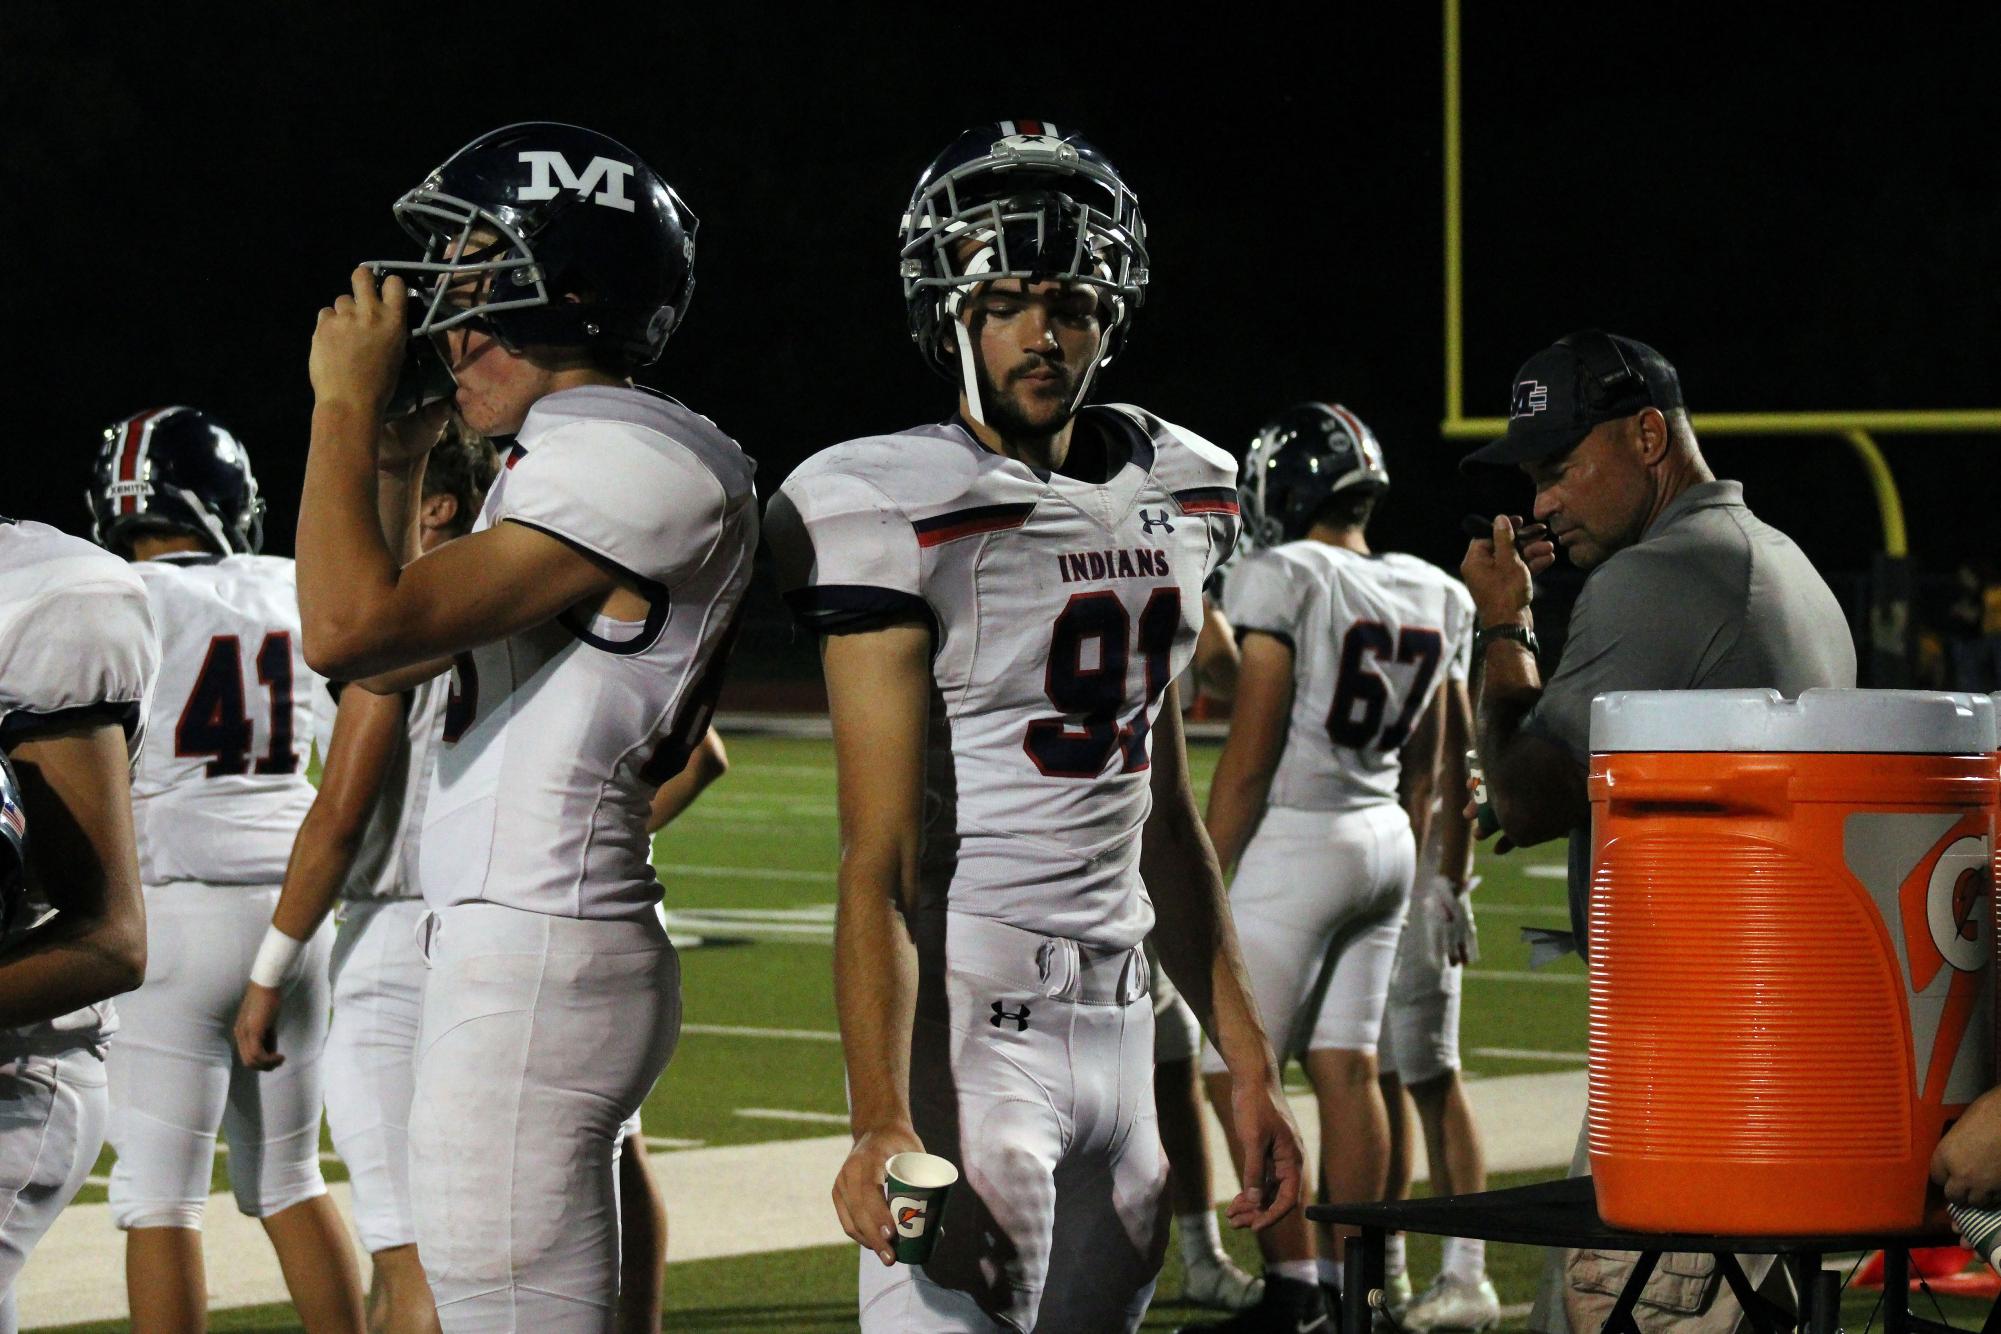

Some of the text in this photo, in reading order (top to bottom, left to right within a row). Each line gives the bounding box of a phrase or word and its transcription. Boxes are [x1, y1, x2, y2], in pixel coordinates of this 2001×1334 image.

[518, 151, 635, 213] M
[1058, 549, 1170, 583] INDIANS
[175, 630, 299, 778] 41
[1022, 587, 1182, 779] 91
[1325, 619, 1443, 750] 67
[890, 1196, 928, 1238] G
